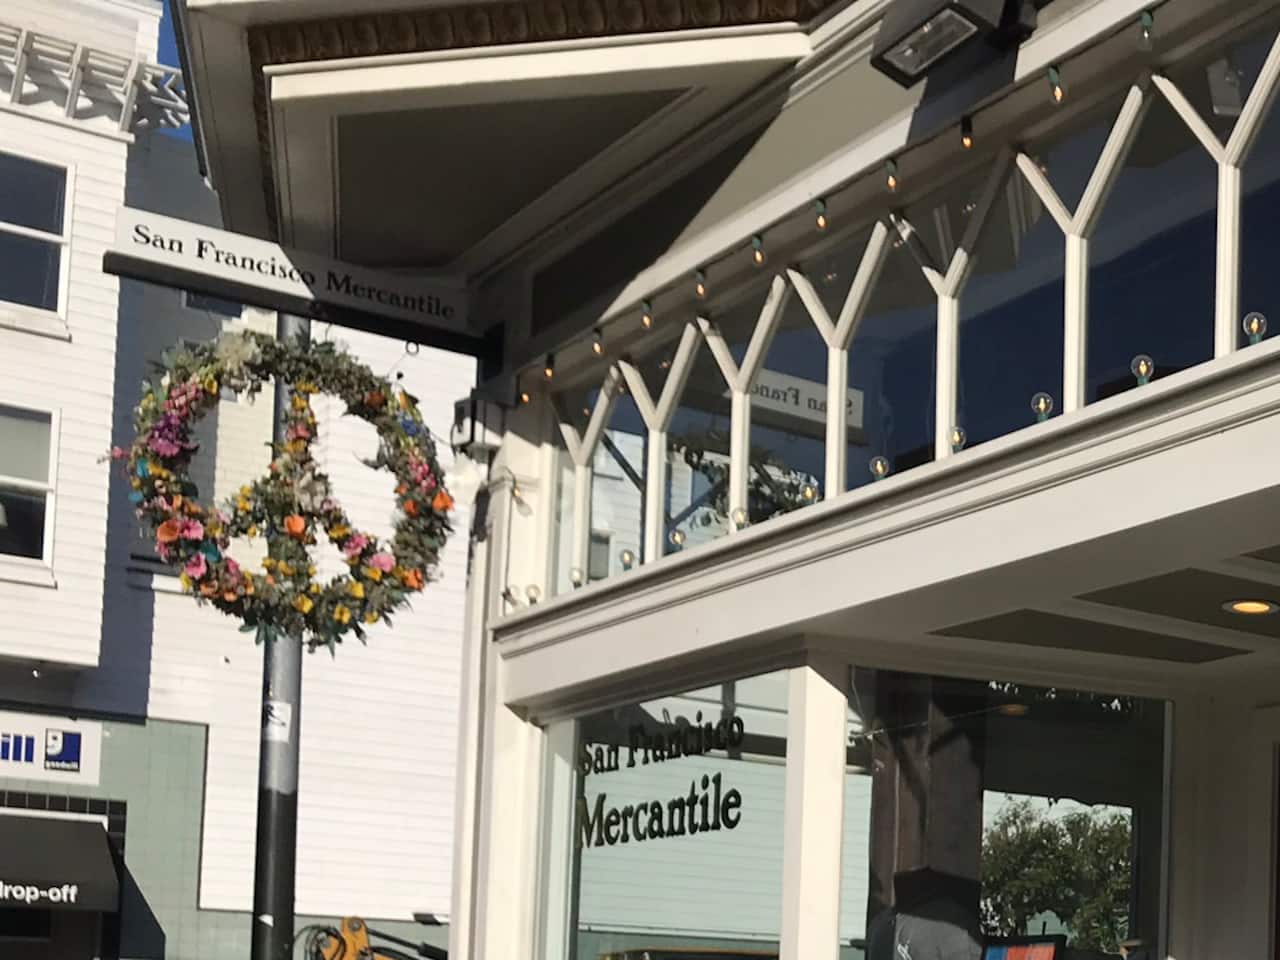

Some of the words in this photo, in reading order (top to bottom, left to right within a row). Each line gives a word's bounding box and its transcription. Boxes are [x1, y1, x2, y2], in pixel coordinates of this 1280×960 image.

[132, 223, 184, 254] San
[195, 237, 317, 287] Francisco
[325, 270, 455, 319] Mercantile
[579, 738, 620, 776] San
[577, 771, 742, 848] Mercantile
